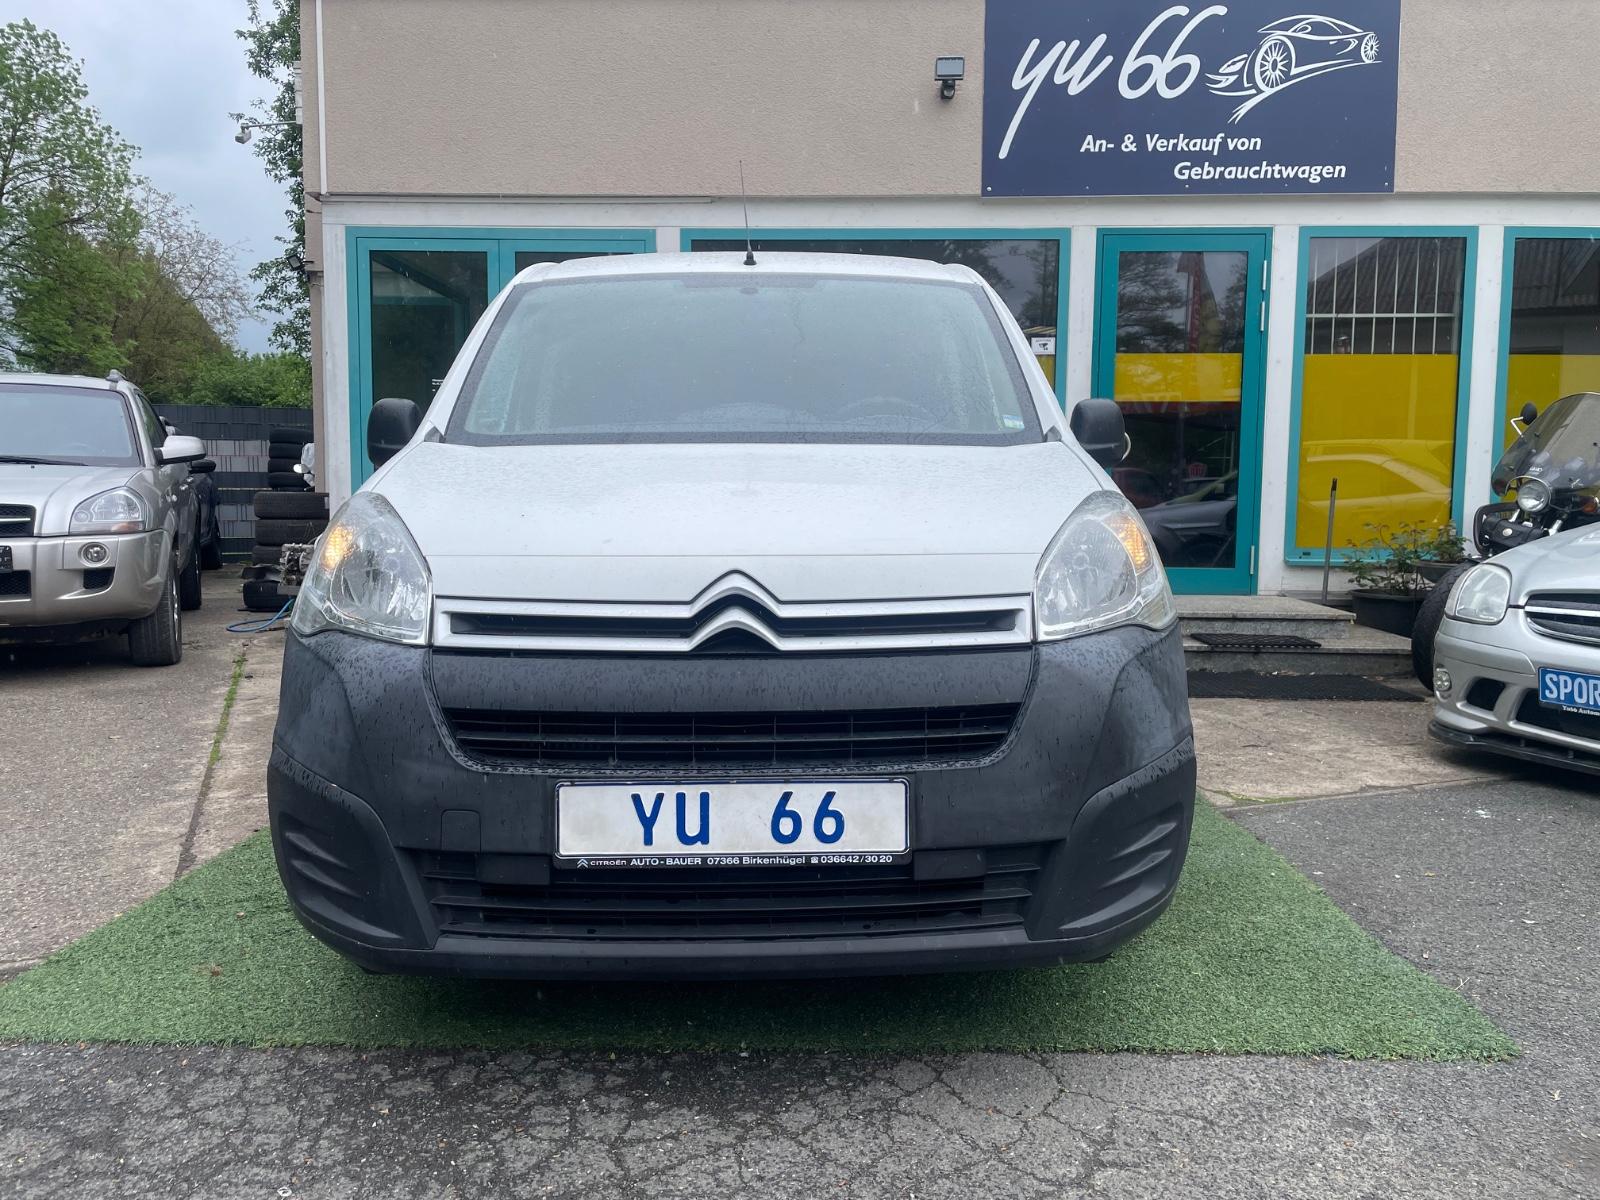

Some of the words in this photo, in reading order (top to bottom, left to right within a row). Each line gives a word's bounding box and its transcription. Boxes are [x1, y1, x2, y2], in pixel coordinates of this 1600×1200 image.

[1117, 4, 1228, 100] 66
[1080, 133, 1115, 153] An-
[1121, 134, 1137, 152] &
[1146, 132, 1225, 155] Verkauf
[1226, 136, 1262, 152] von
[1173, 161, 1348, 184] Gebrauchtwagen
[630, 790, 711, 847] YU
[770, 790, 846, 846] 66
[706, 856, 740, 866] 07366
[742, 855, 806, 866] Birkenhügel
